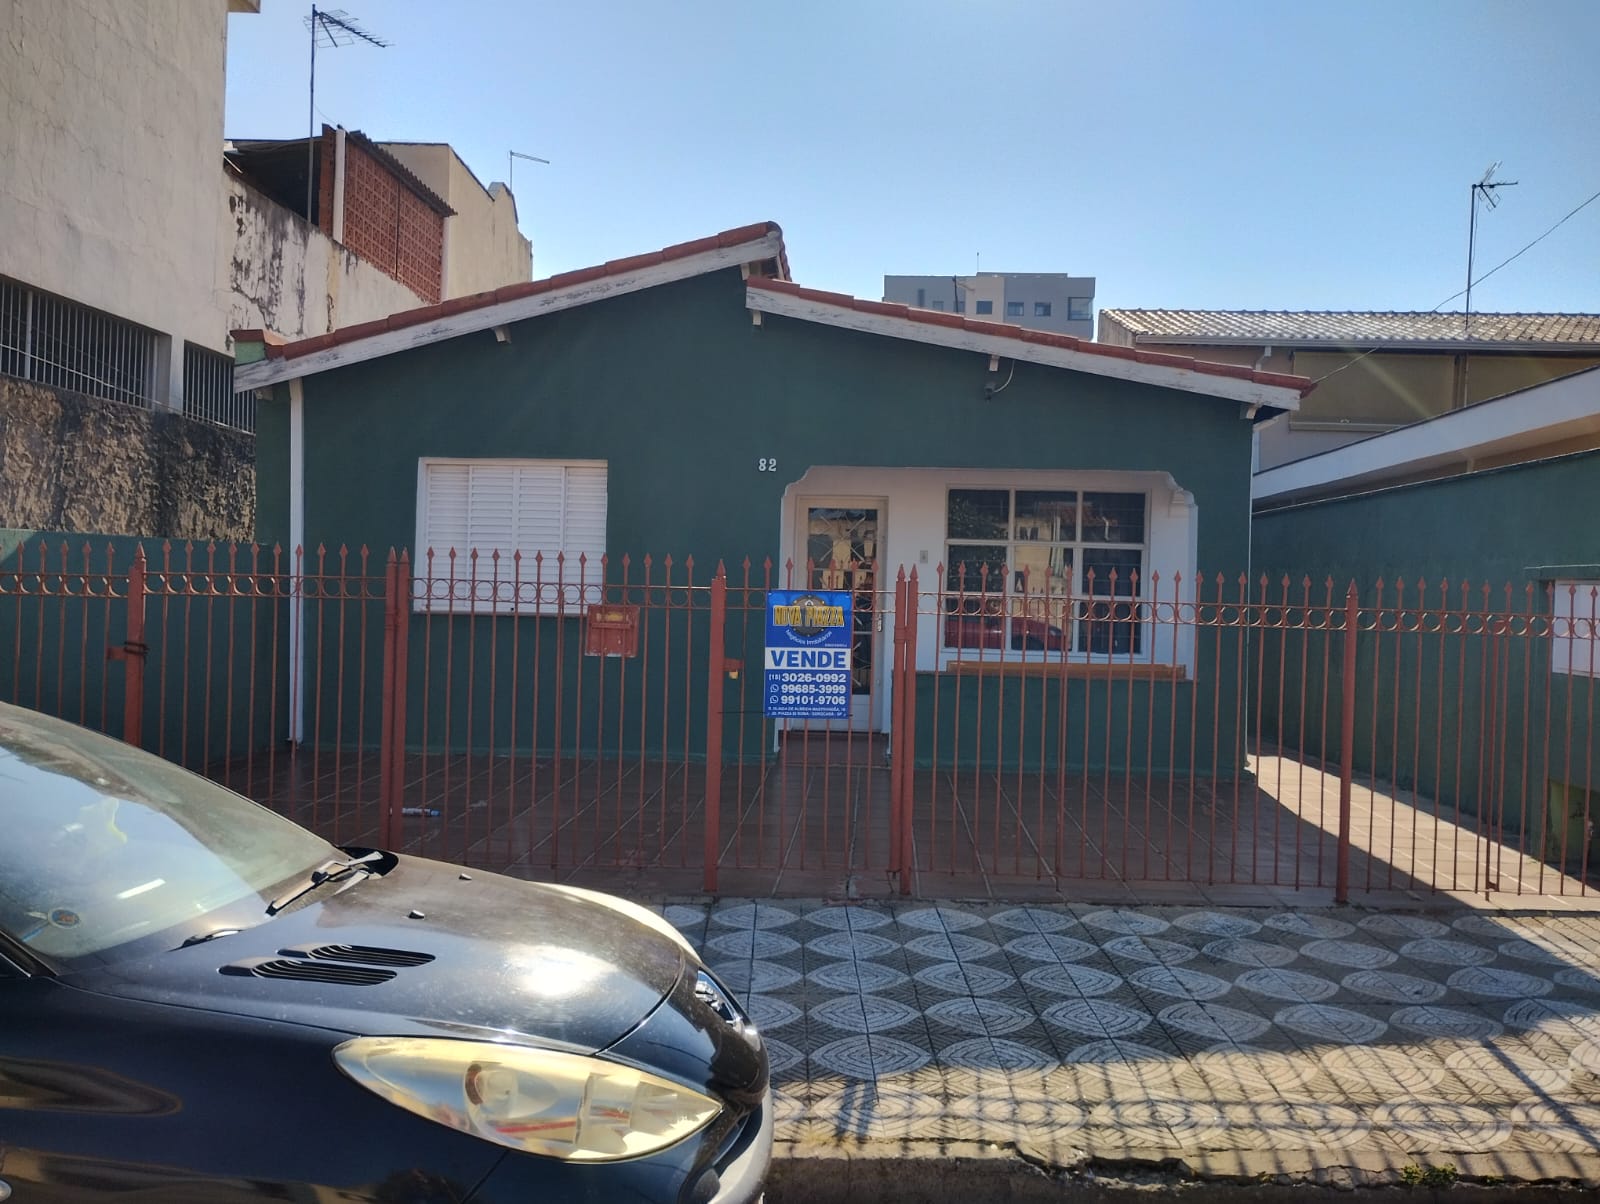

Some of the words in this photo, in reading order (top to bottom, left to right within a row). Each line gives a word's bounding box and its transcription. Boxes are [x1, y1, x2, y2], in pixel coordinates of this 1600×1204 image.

[758, 458, 777, 472] 82
[773, 606, 802, 626] NOVA
[806, 606, 844, 627] PIAZZA
[770, 650, 846, 668] VENDE
[781, 673, 847, 683] 3026-0992
[781, 684, 846, 694] 99685-3999
[780, 695, 846, 705] 99101-9706
